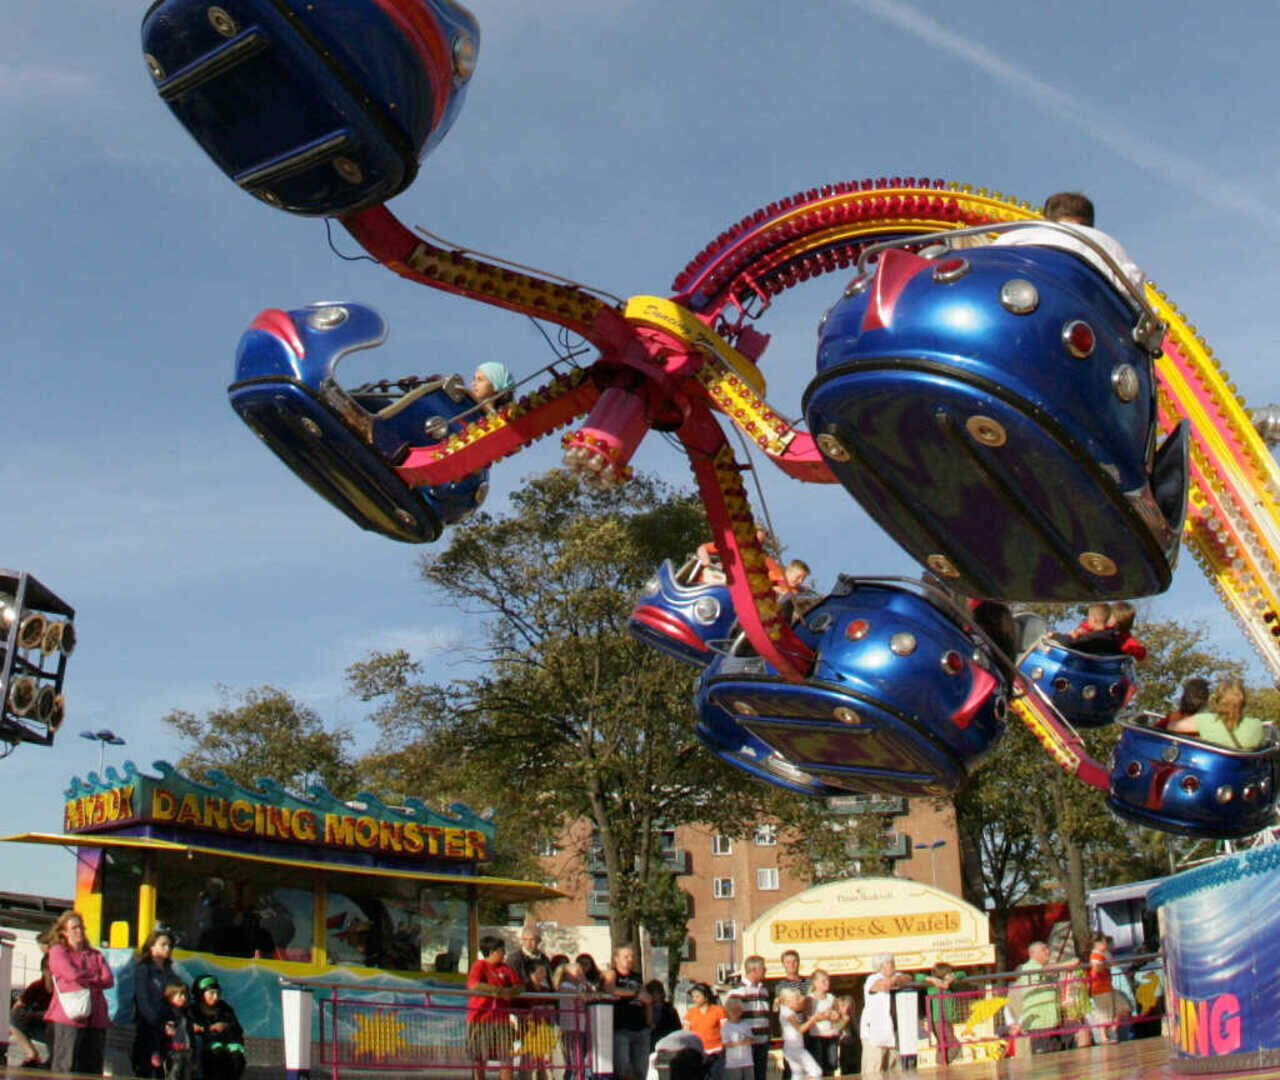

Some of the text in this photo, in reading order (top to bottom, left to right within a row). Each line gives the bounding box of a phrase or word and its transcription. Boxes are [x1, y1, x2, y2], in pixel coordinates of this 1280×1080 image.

[151, 788, 489, 860] DANCING MONSTER
[775, 913, 959, 941] Poffertjes & Wafels
